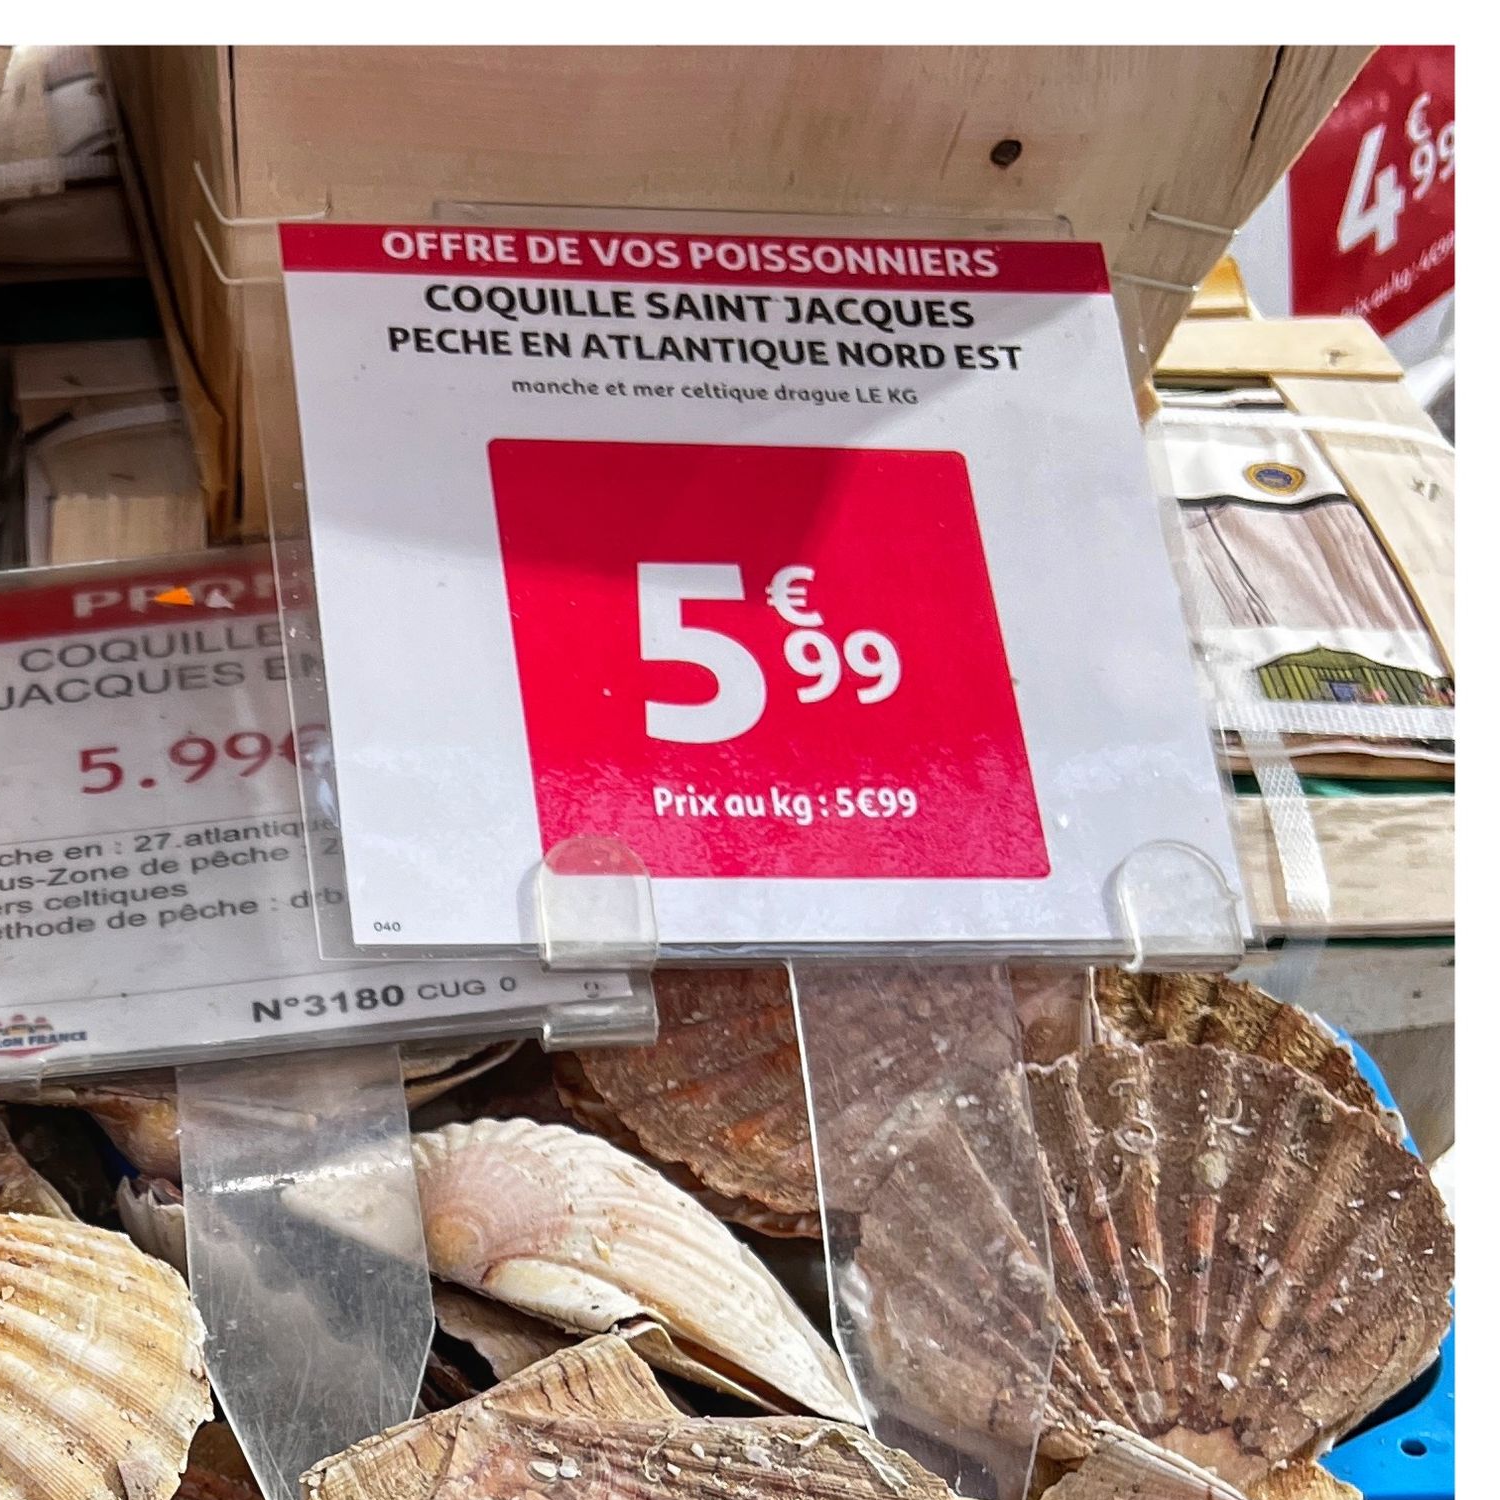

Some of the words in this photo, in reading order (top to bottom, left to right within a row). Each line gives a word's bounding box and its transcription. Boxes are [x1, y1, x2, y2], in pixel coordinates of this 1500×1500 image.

[1337, 123, 1406, 255] 4
[382, 230, 519, 263] OFFRE
[526, 234, 583, 266] DE
[589, 237, 681, 269] VOS
[691, 241, 999, 278] POISSONNIERS
[424, 284, 635, 322] COQUILLE
[646, 291, 773, 323] SAINT
[783, 296, 975, 333] JACQUES
[388, 326, 513, 356] PECHE
[520, 331, 572, 358] EN
[582, 333, 830, 370] ATLANTIQUE
[837, 341, 946, 370] NORD
[956, 345, 1022, 370] EST
[511, 378, 599, 396] manche
[605, 381, 628, 397] et
[633, 384, 674, 399] mer
[681, 383, 769, 402] celtique
[774, 385, 850, 406] drague
[856, 387, 883, 404] LE
[888, 388, 919, 405] KG
[19, 623, 285, 674] COQUILLE
[636, 562, 768, 744] 5
[653, 783, 718, 817] Prix
[724, 793, 765, 818] au
[770, 785, 814, 826] kg
[836, 786, 918, 818] 5€99
[64, 844, 103, 860] en
[140, 858, 179, 876] de
[191, 847, 289, 875] pêche
[44, 883, 189, 911] celtiques
[106, 910, 147, 930] de
[158, 899, 259, 929] pêche
[373, 921, 401, 932] 040
[252, 984, 405, 1024] N°3180
[416, 980, 486, 1001] CUG
[28, 1031, 88, 1046] FRANCE
